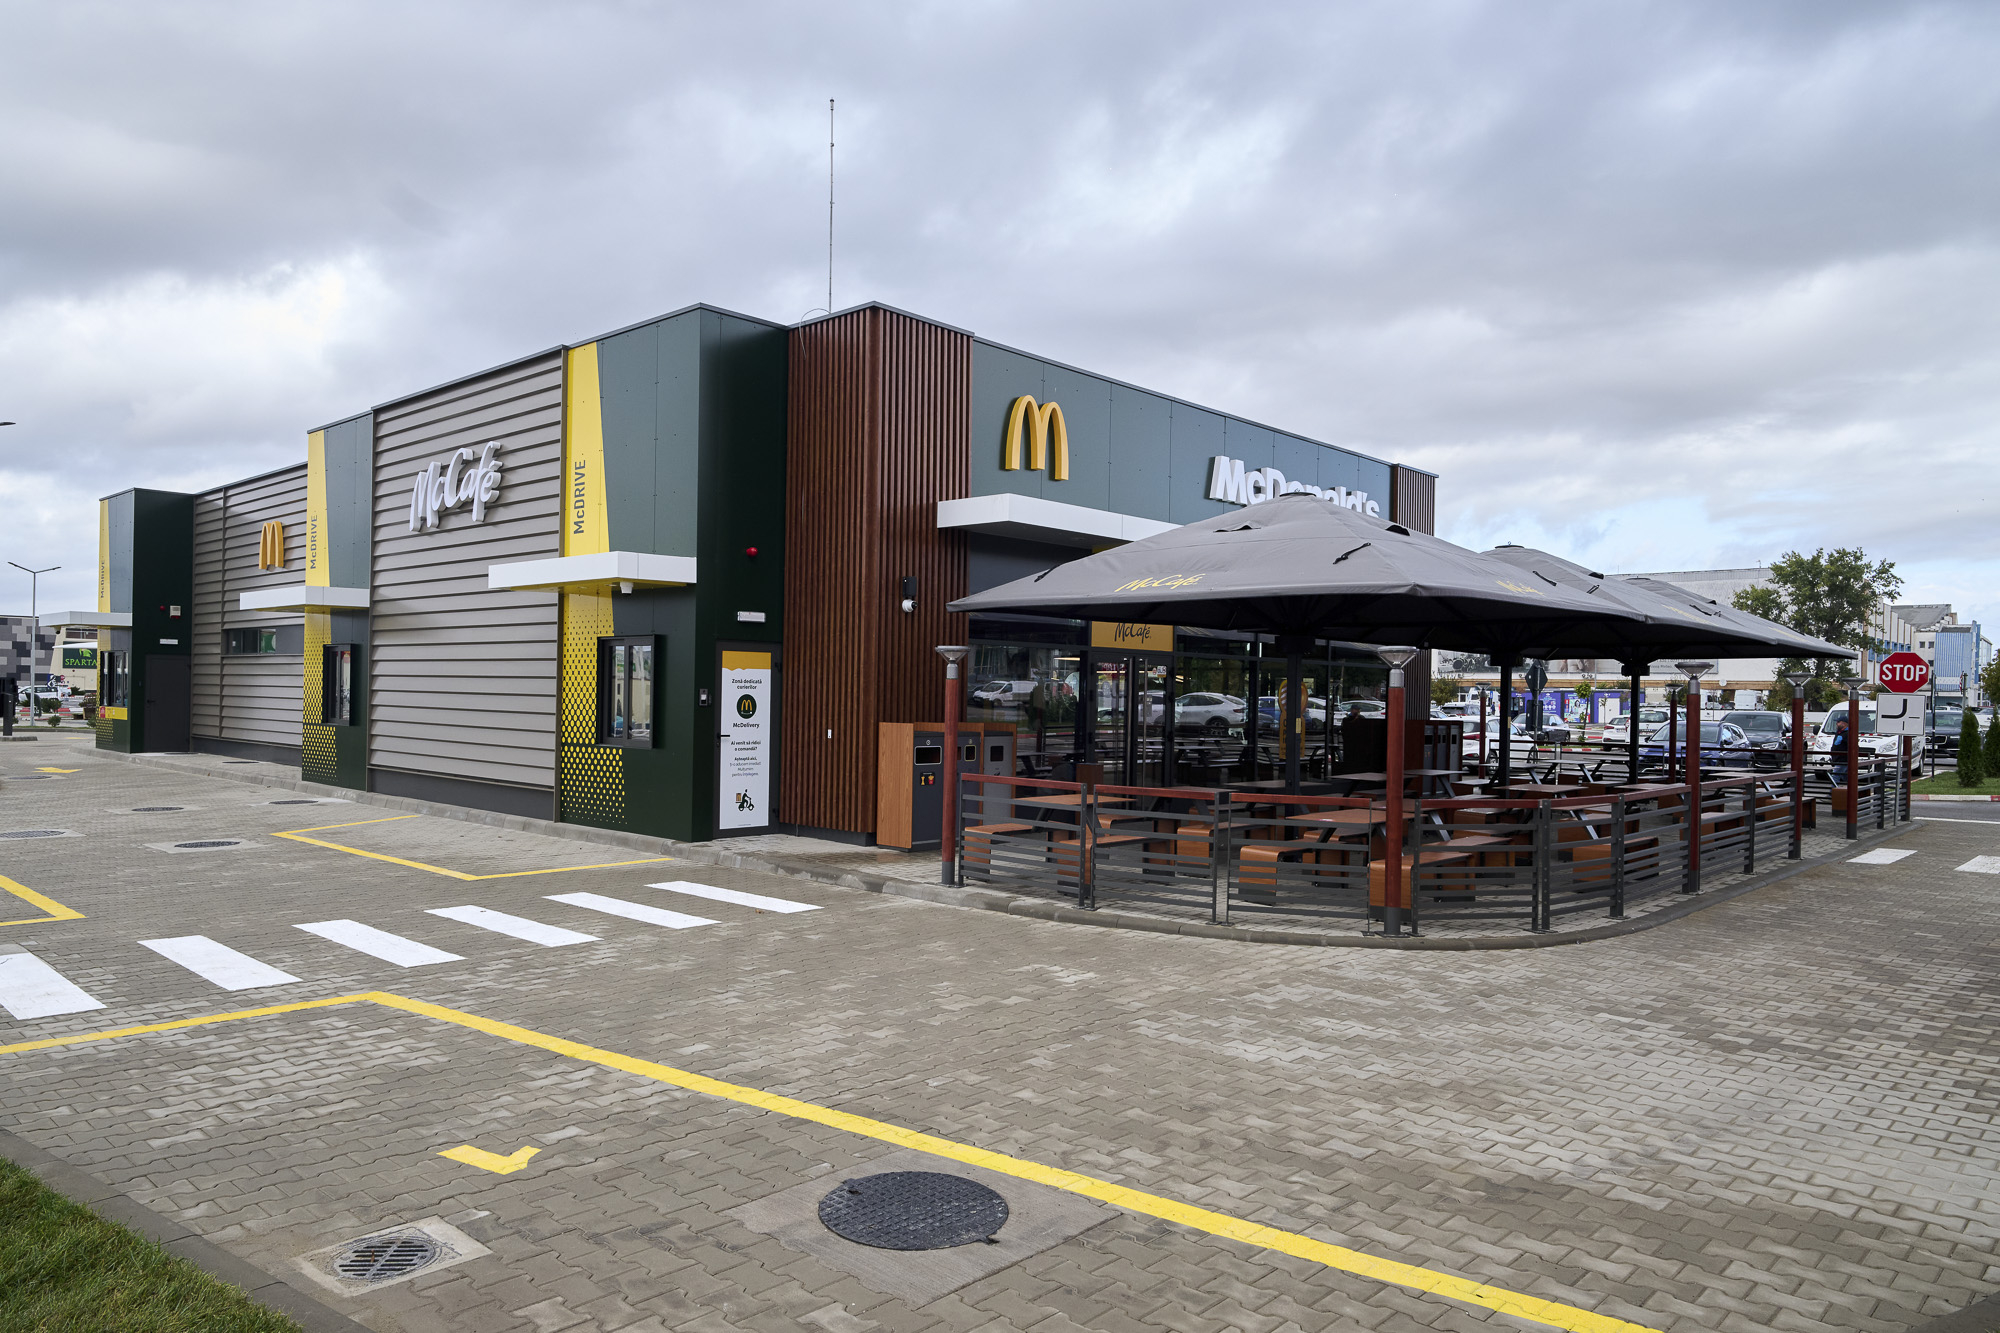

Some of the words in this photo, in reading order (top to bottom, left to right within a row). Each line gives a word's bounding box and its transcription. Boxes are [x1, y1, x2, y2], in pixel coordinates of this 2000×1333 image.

[410, 441, 503, 532] McCafé
[573, 459, 586, 535] McDRIVE
[309, 514, 318, 570] McDRIVE
[1881, 663, 1927, 682] STOP
